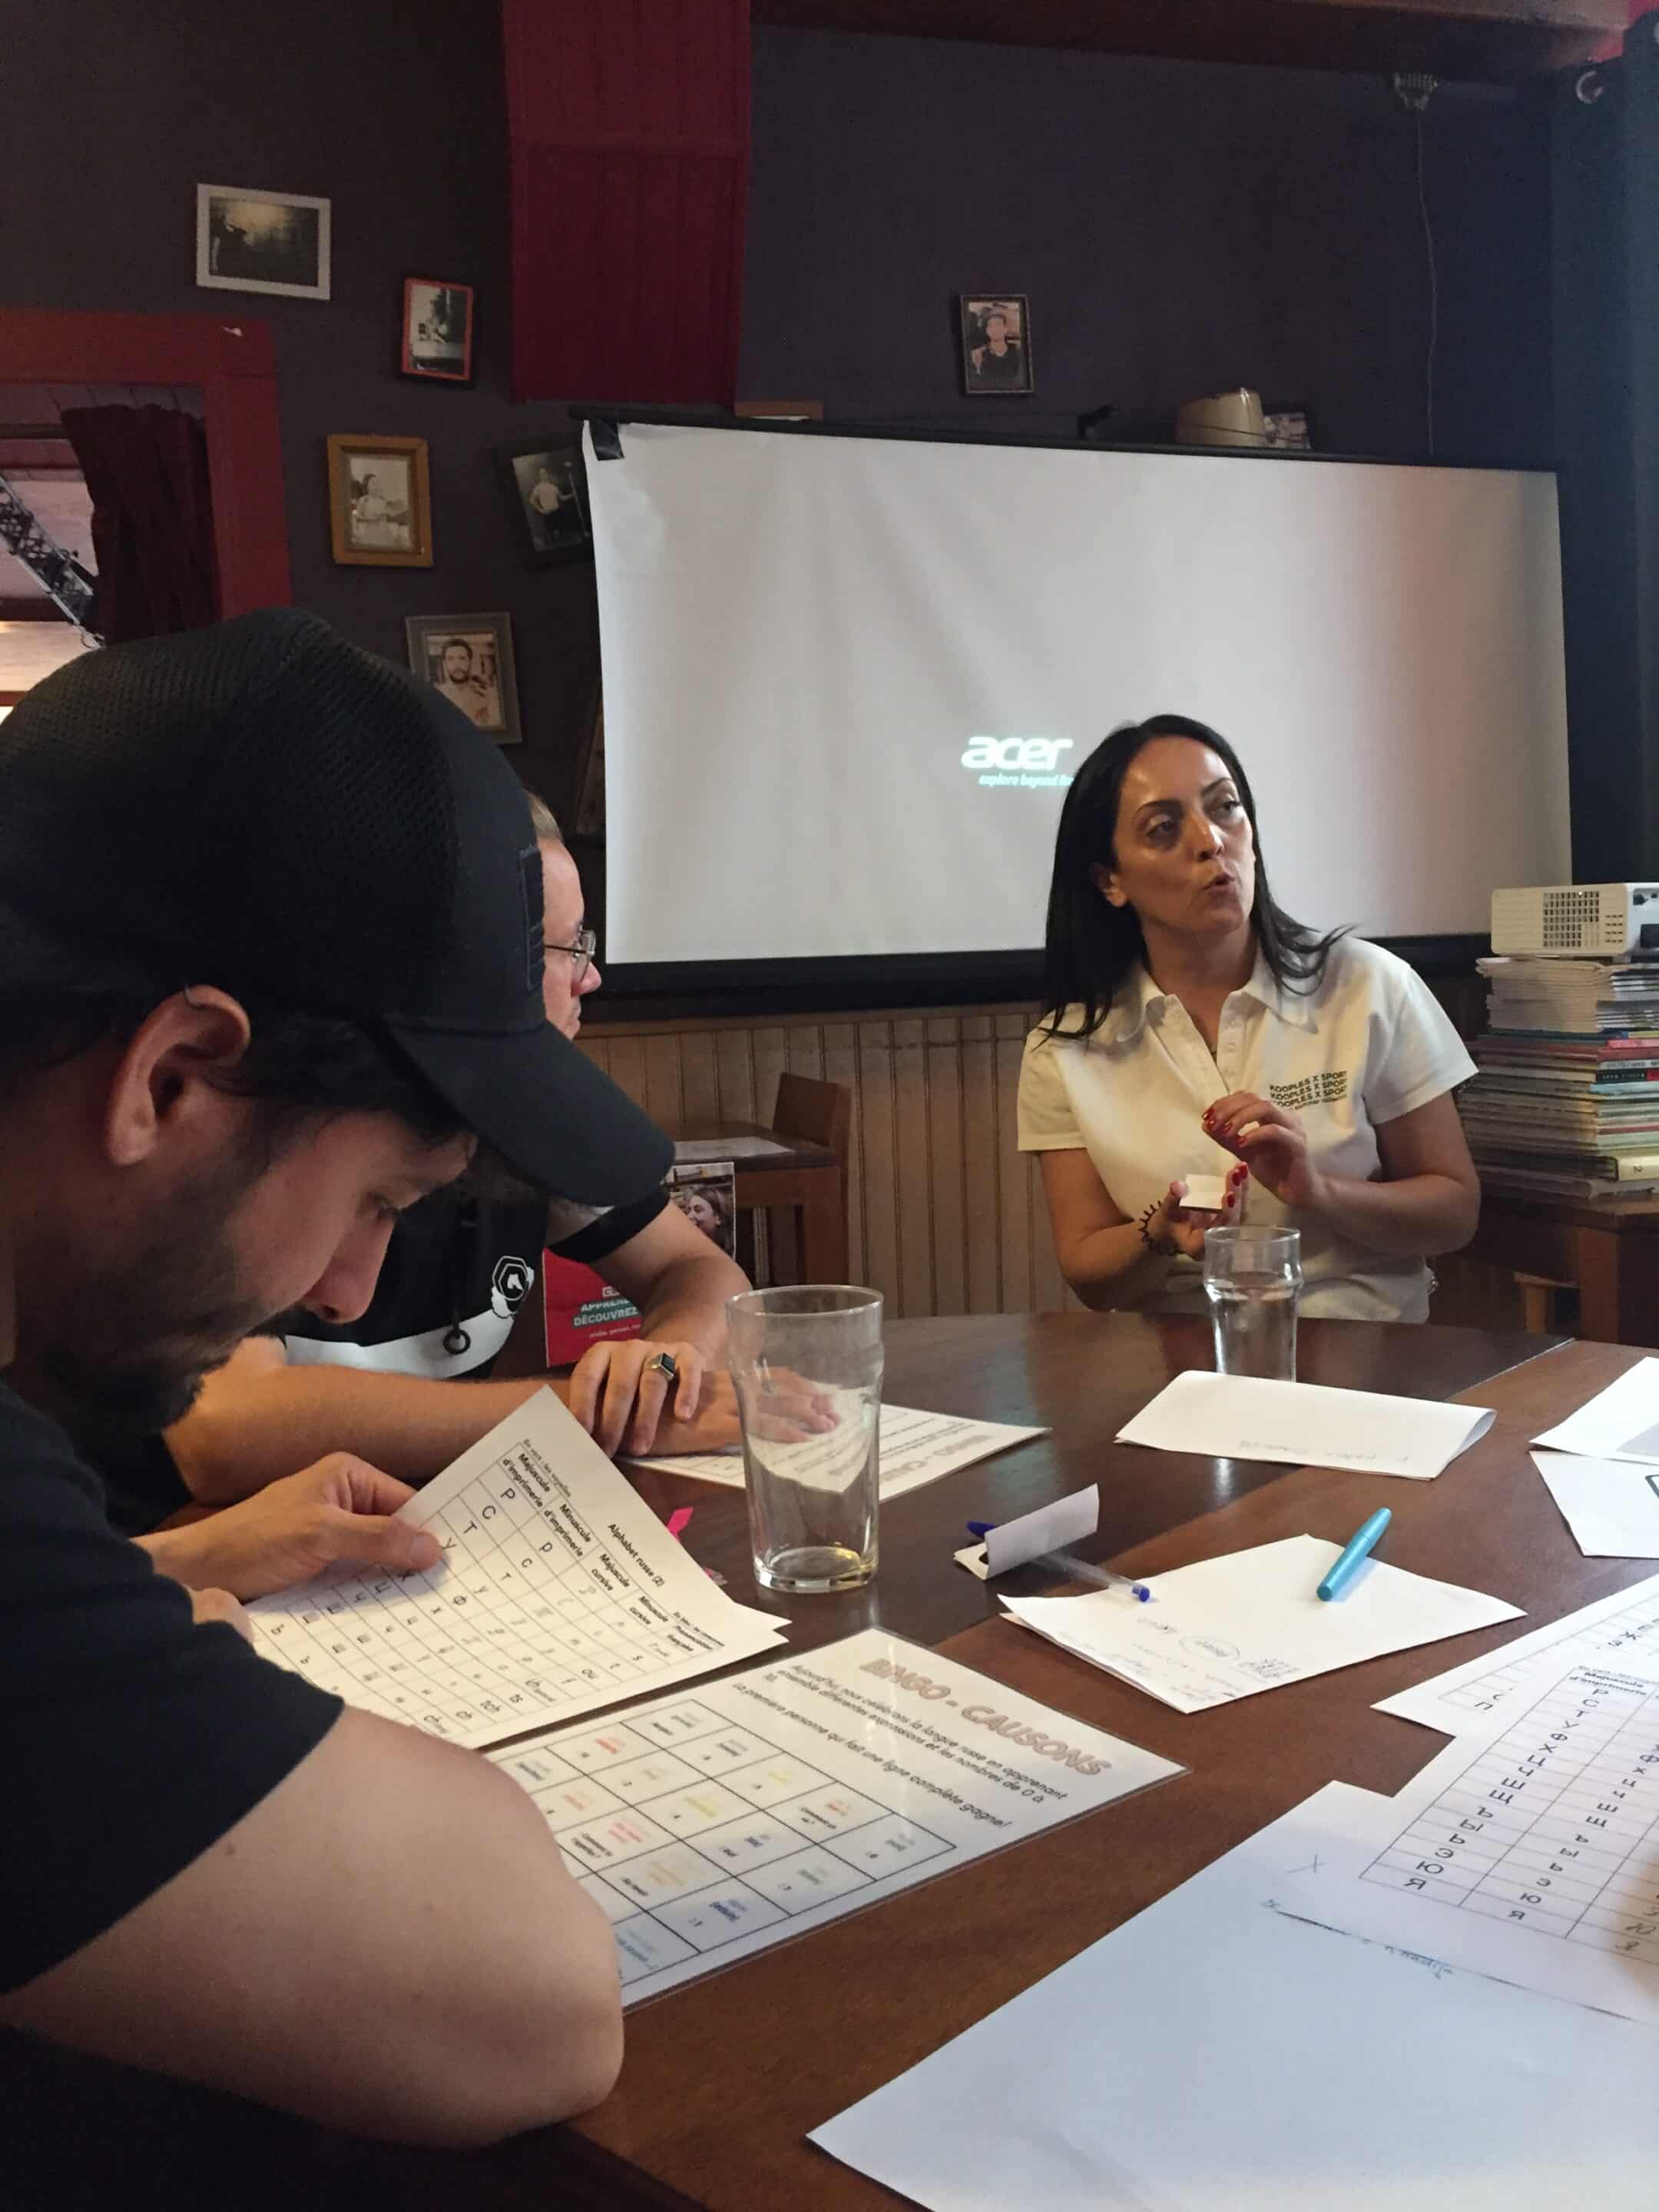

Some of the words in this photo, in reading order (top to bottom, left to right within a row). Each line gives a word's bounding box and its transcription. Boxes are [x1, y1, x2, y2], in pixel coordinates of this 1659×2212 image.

[961, 736, 1073, 770] acer
[979, 774, 1019, 786] explore
[1020, 773, 1058, 788] beyond
[1273, 1093, 1313, 1107] OOPLES
[574, 1306, 639, 1326] DÉCOUVREZ
[502, 1458, 543, 1508] d'imprimerie
[518, 1452, 551, 1493] Majuscule
[544, 1509, 583, 1557] d'imprimerie
[559, 1504, 591, 1543] Minuscule
[608, 1523, 638, 1558] Alphabet
[636, 1555, 654, 1577] russe
[652, 1575, 665, 1587] (2)
[591, 1568, 614, 1591] cursive
[599, 1553, 630, 1588] Majuscule
[859, 1658, 951, 1700] BINGO
[962, 1705, 1112, 1776] CAUSONS
[781, 1710, 829, 1734] personne
[827, 1733, 846, 1743] qui
[844, 1740, 866, 1753] fait
[863, 1751, 883, 1763] une
[882, 1760, 910, 1777] ligne
[910, 1775, 963, 1804] complète
[959, 1803, 1013, 1828] gagne!
[910, 1720, 922, 1729] la
[922, 1726, 959, 1747] langue
[959, 1747, 987, 1760] russe
[986, 1760, 1002, 1769] en
[1002, 1767, 1068, 1800] apprenant
[924, 1742, 940, 1751] et
[939, 1747, 955, 1759] les
[955, 1757, 1002, 1783] nombres
[1002, 1780, 1021, 1791] de
[1518, 1766, 1535, 1777] Ч
[1526, 1754, 1546, 1767] Ц
[1500, 1777, 1526, 1790] Ш
[1488, 1790, 1514, 1804] Щ
[1459, 1819, 1484, 1832] Ы
[1434, 1848, 1455, 1859] Э
[1416, 1861, 1444, 1874] Ю
[1404, 1877, 1427, 1890] Я
